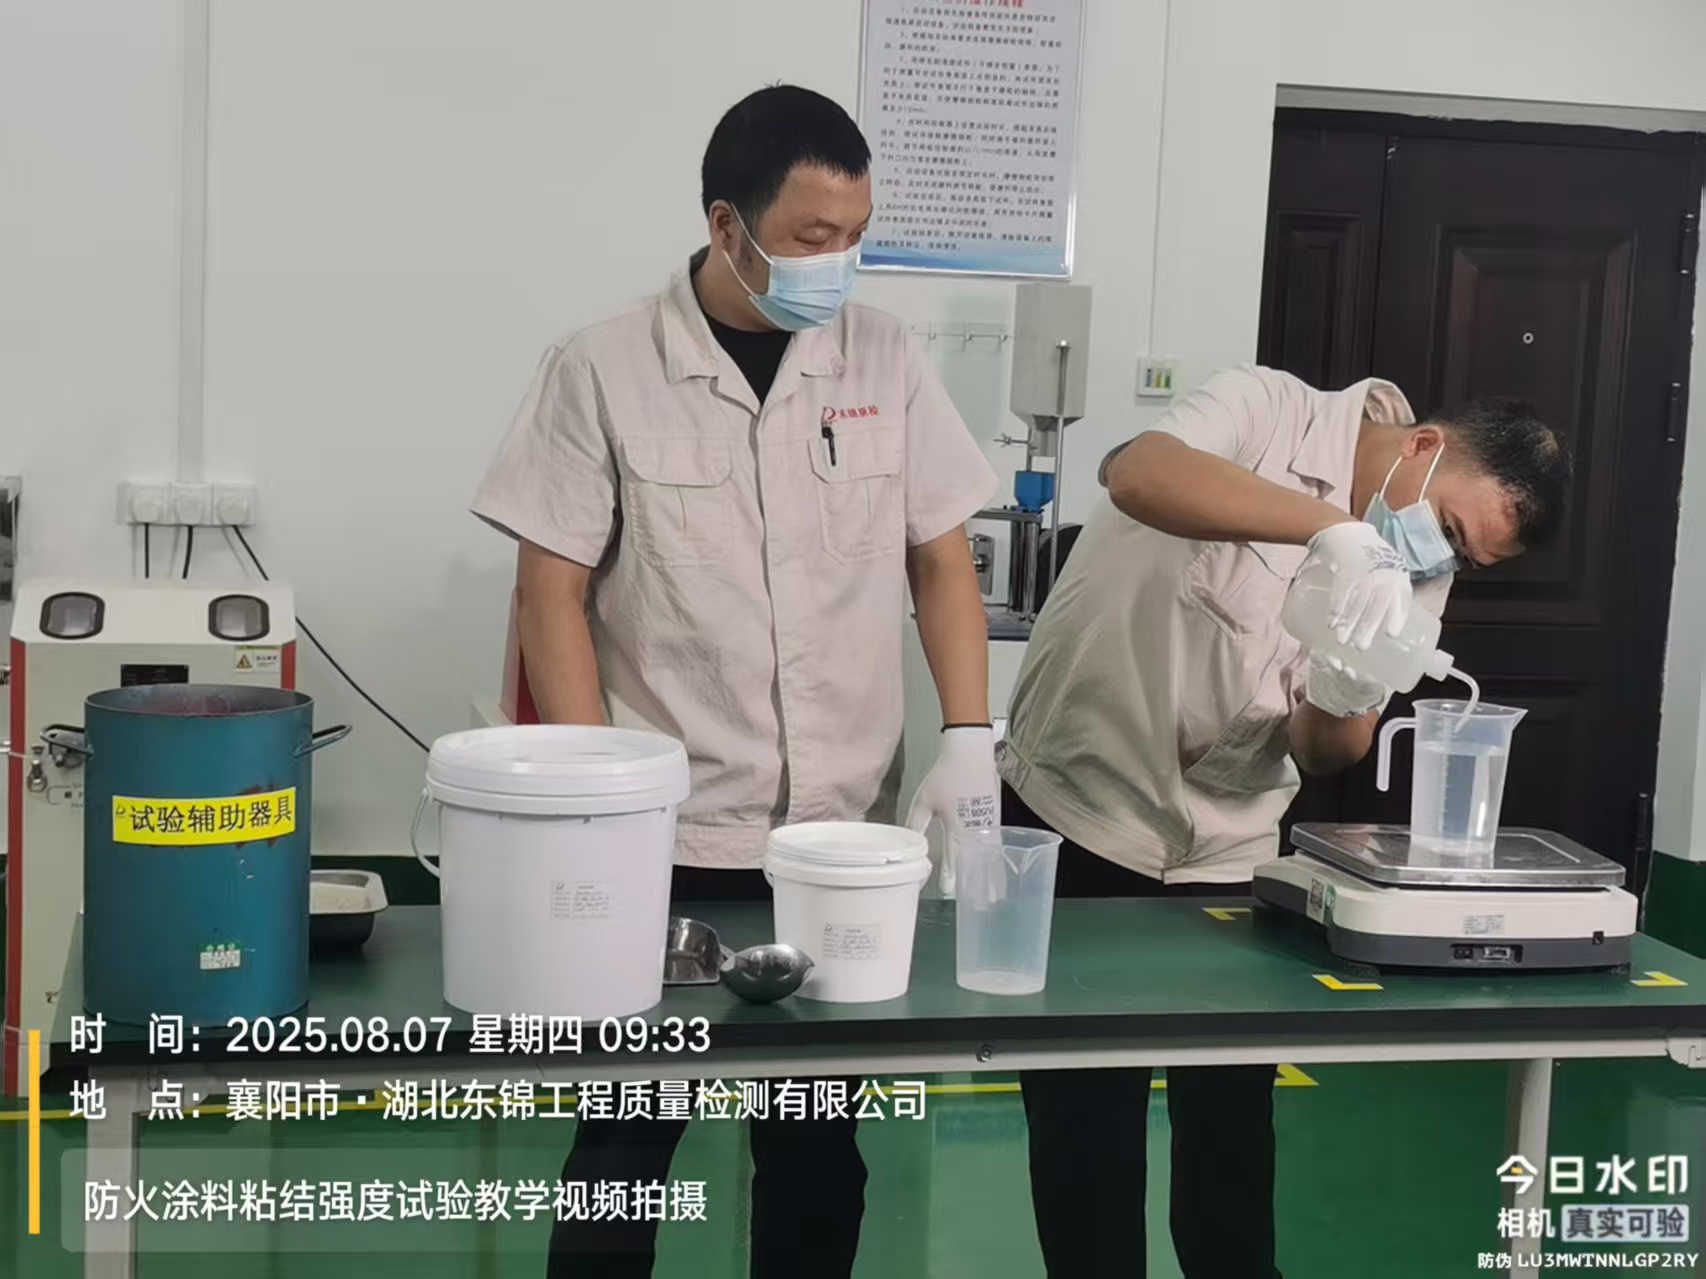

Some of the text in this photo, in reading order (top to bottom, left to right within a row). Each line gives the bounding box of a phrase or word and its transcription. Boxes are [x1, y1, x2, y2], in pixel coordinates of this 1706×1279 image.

[129, 795, 292, 834] 试验辅助器具
